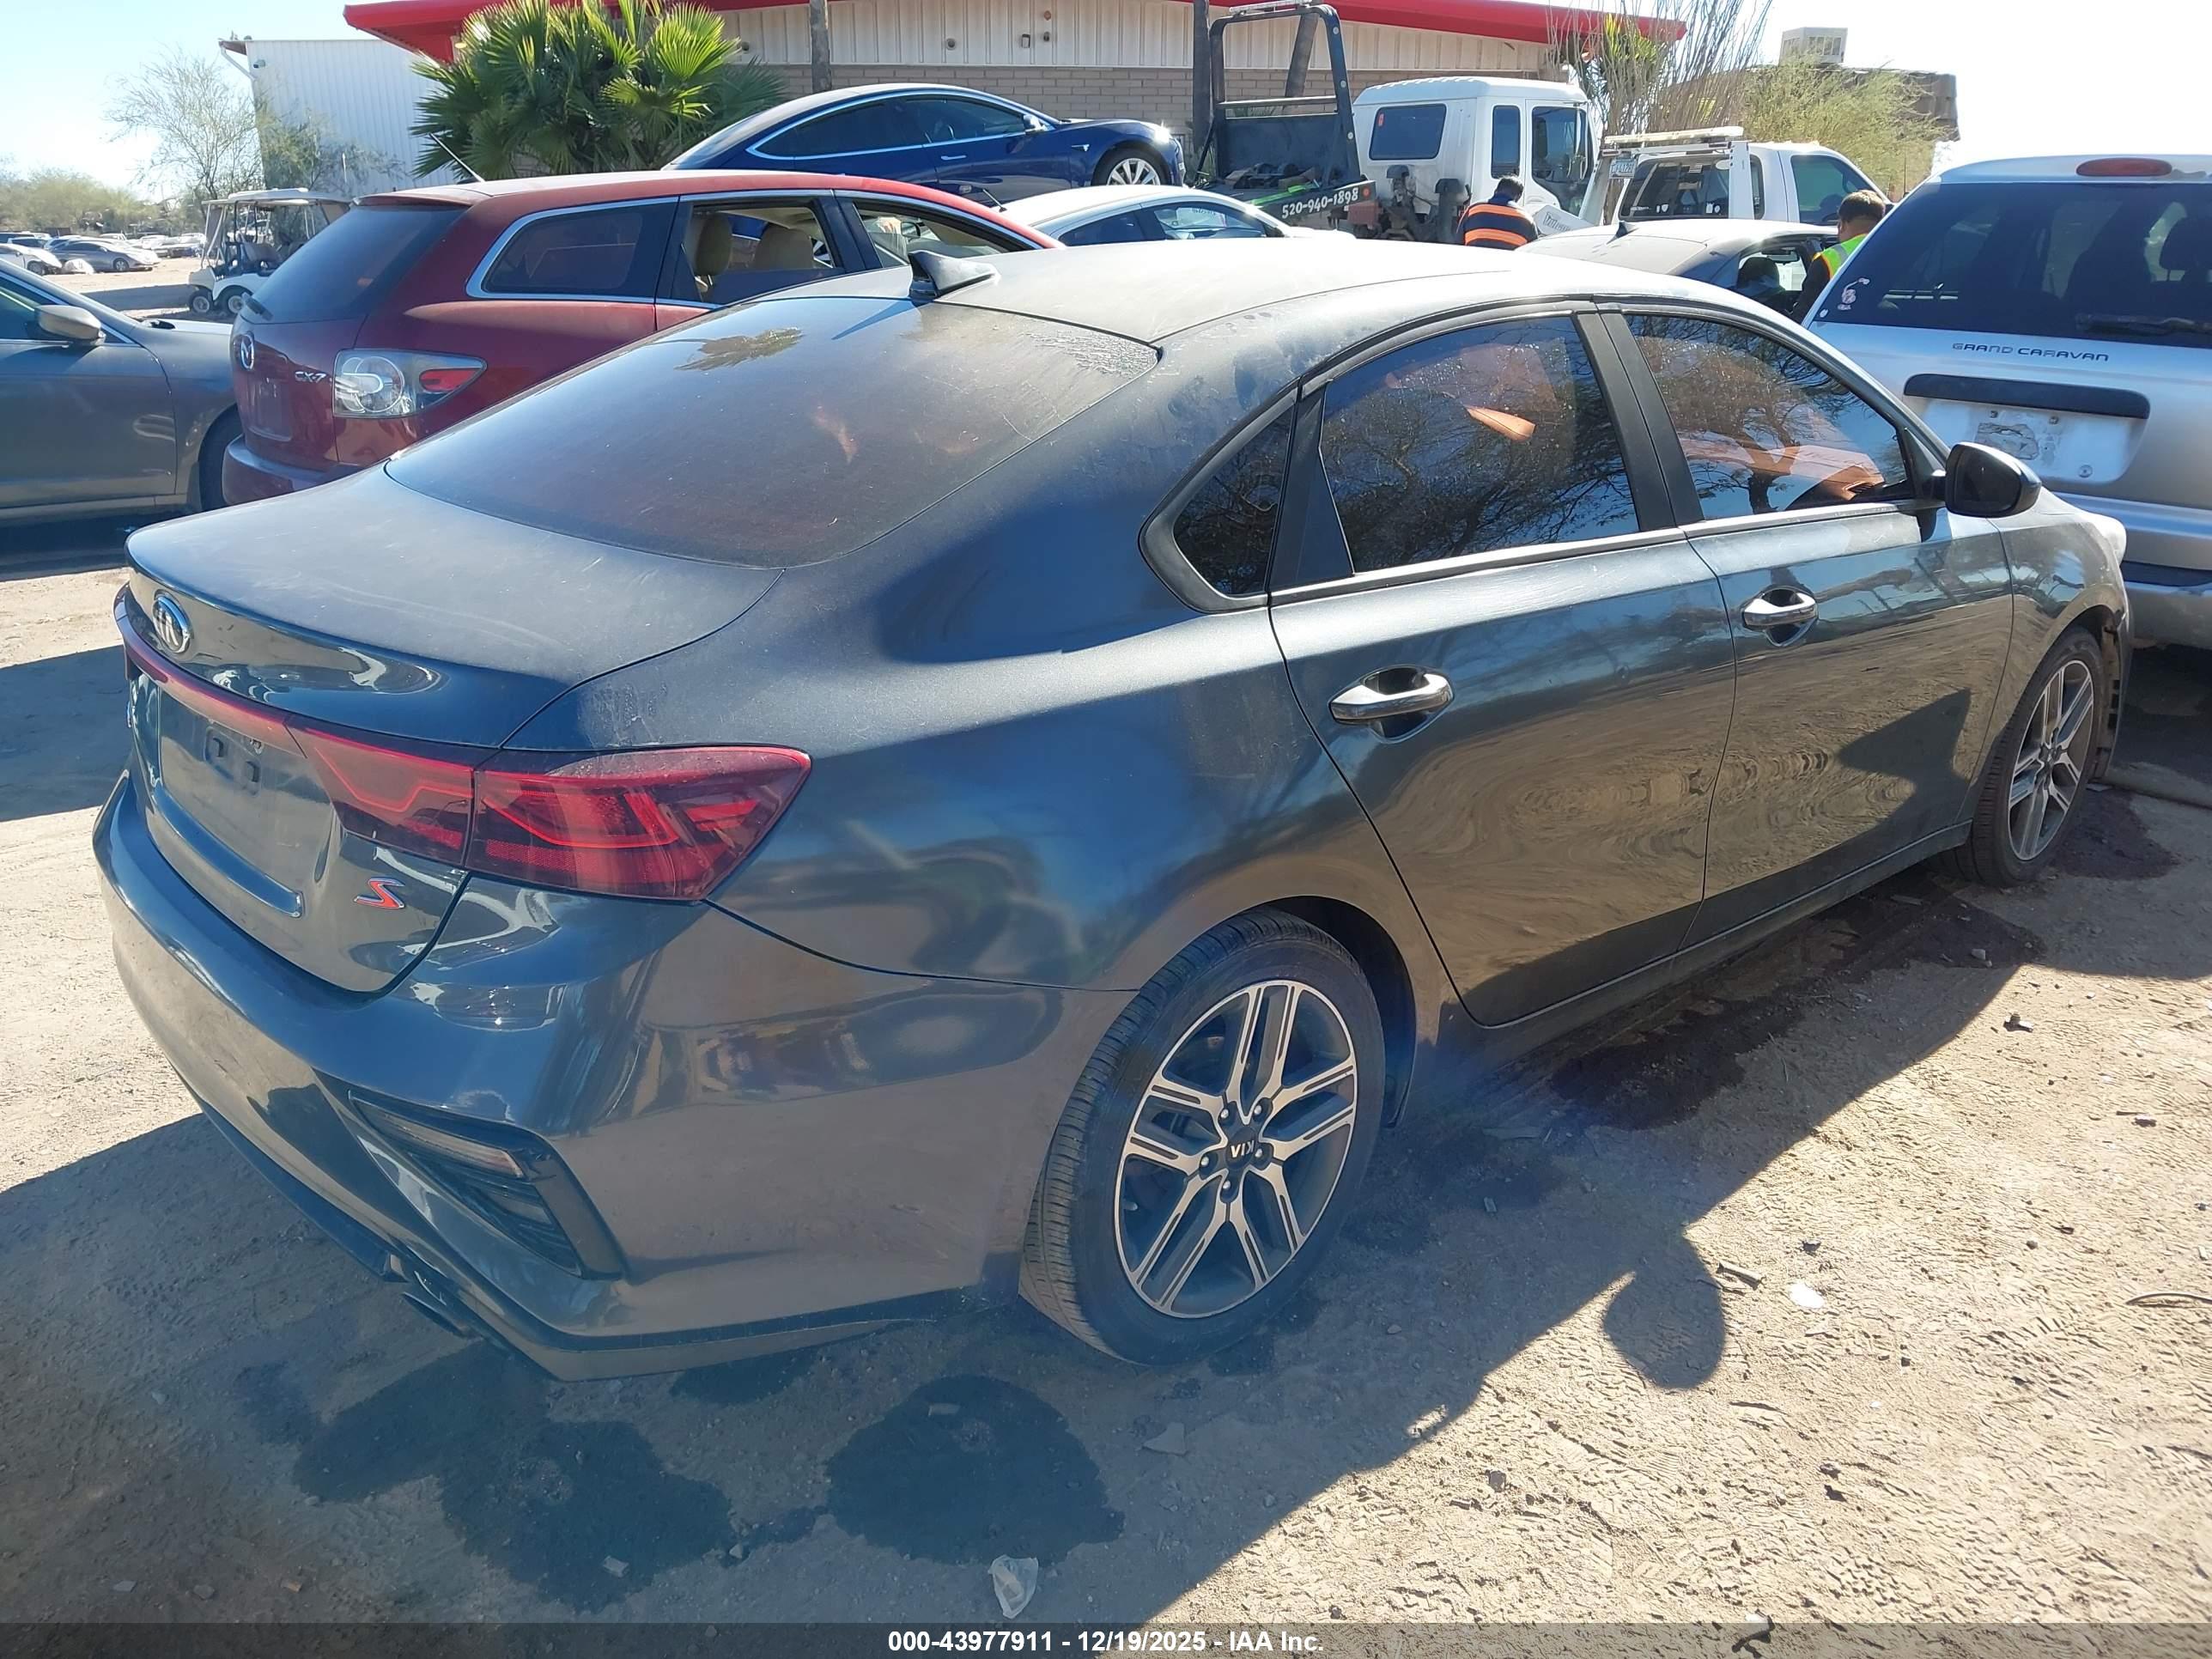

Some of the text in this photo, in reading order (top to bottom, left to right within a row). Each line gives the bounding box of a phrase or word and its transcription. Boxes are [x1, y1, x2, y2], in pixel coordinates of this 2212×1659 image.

[1282, 186, 1359, 219] 520-940-1898
[1952, 343, 2110, 362] GRAND CARAVAN
[295, 371, 327, 383] CX-7
[353, 877, 406, 910] S
[1230, 1139, 1255, 1158] KIA
